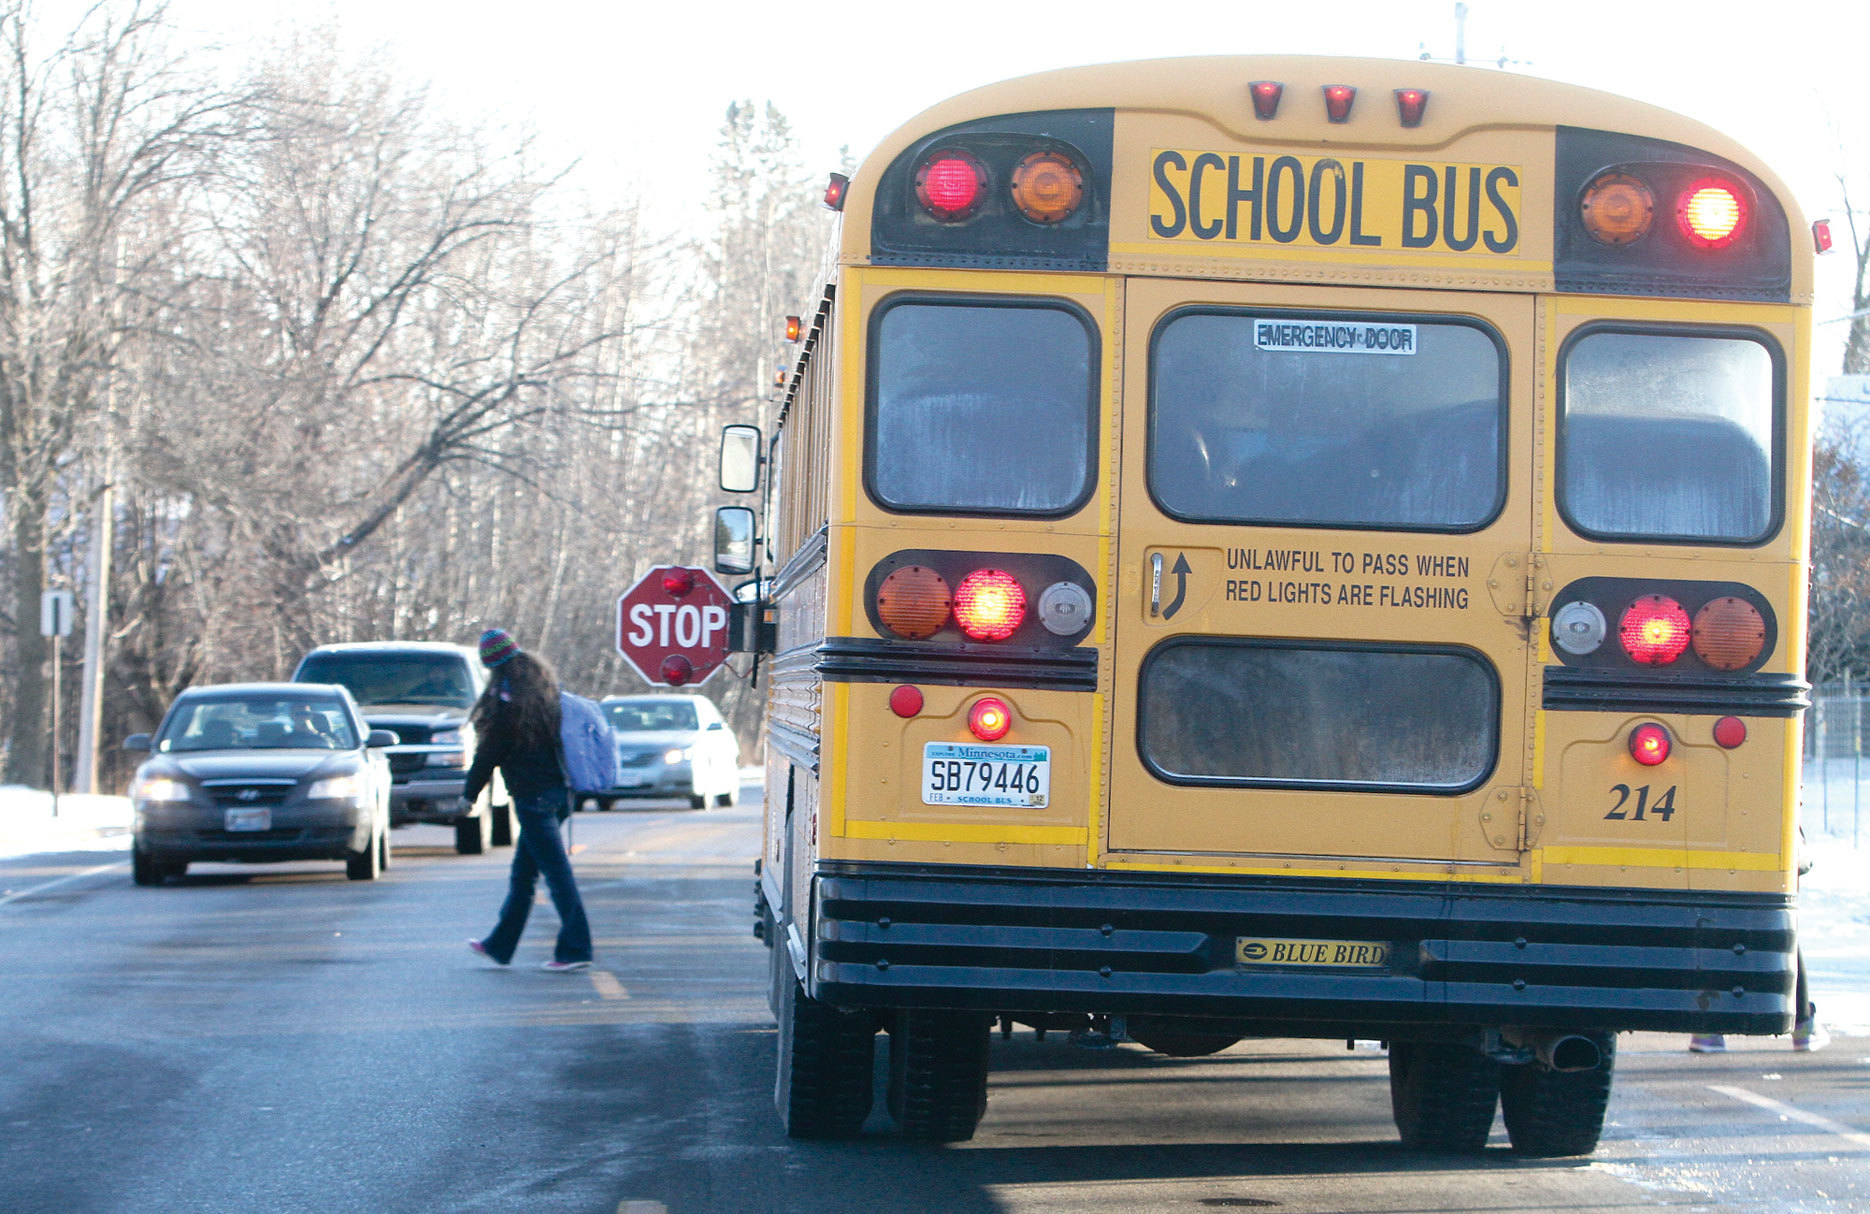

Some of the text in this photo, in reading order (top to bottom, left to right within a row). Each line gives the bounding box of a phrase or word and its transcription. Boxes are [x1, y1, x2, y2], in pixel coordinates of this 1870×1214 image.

[1151, 151, 1519, 254] SCHOOL BUS
[1257, 324, 1412, 350] EMERGENCY DOOR
[1227, 548, 1469, 577] UNLAWFUL TO PASS WHEN
[1226, 580, 1469, 609] RED LIGHTS ARE FLASHING
[628, 603, 726, 648] STOP
[931, 761, 1039, 793] SB79446
[929, 793, 943, 802] FEB
[1603, 783, 1677, 822] 214
[1272, 943, 1385, 964] BLUE BIRD
